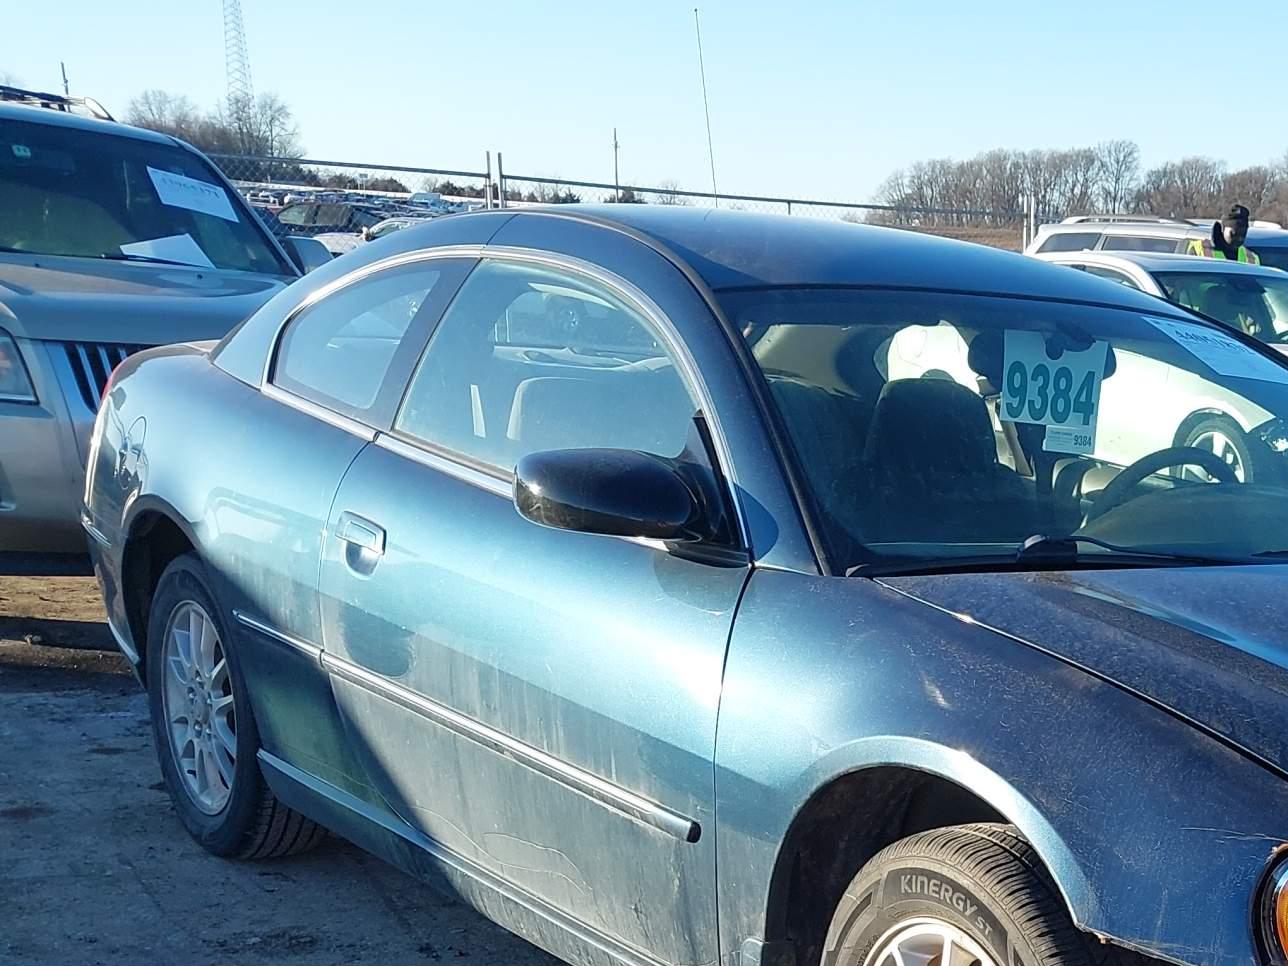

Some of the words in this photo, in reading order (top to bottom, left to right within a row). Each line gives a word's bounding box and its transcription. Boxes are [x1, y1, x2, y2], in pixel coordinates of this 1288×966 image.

[1005, 360, 1096, 426] 9384
[1073, 434, 1092, 448] 9384
[975, 916, 993, 936] ST
